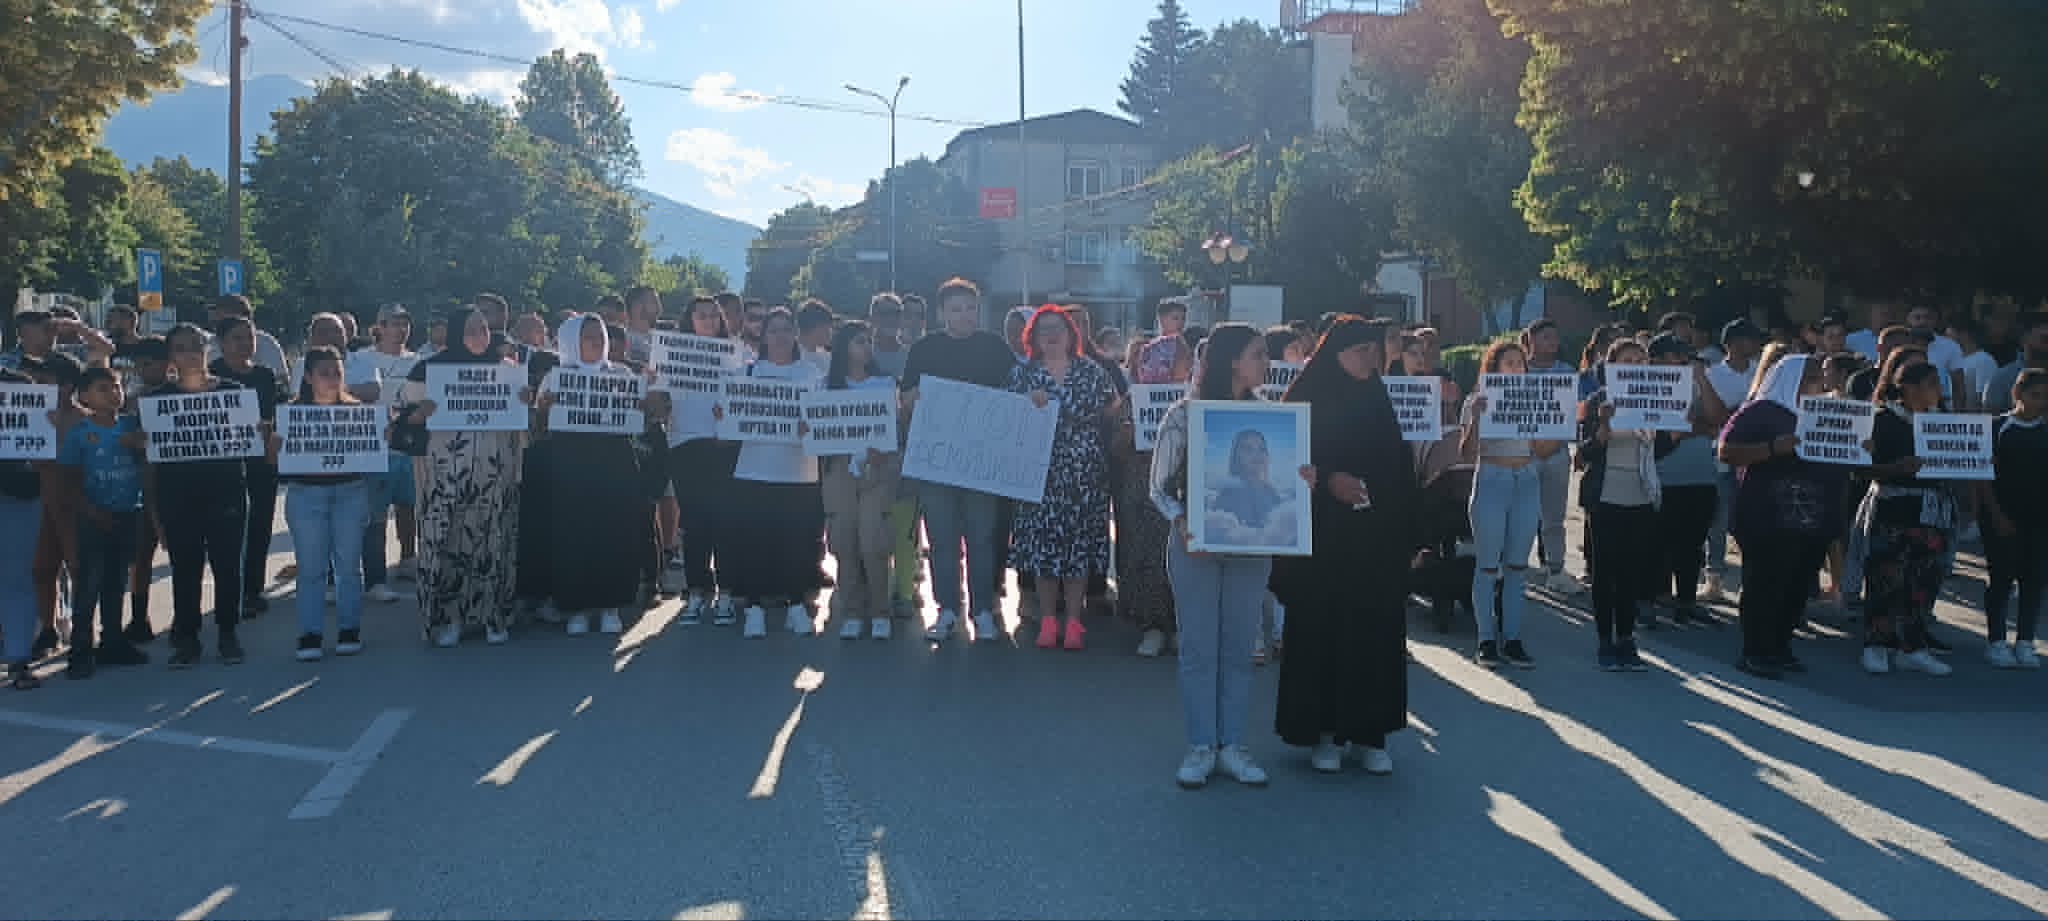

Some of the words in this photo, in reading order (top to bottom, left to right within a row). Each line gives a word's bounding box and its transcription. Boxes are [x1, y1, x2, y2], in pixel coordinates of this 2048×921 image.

[144, 255, 157, 288] P
[224, 264, 237, 294] P
[559, 372, 587, 391] ЦЕЛ
[589, 374, 639, 394] НАРОД
[157, 400, 179, 416] ДО
[182, 396, 221, 410] КОГА
[446, 399, 508, 412] ПОЛИЦИЈА
[587, 391, 608, 408] ВО
[173, 411, 229, 427] МОЛЧИ
[151, 428, 232, 445] ПРАВДАТА
[234, 424, 255, 440] ЗА
[312, 423, 331, 438] ЗА
[332, 423, 377, 438] ЖЕНАТА
[846, 423, 873, 440] МИР
[159, 444, 219, 459] ЖЕНАТА
[303, 439, 380, 456] МАКЕДОНИЈА
